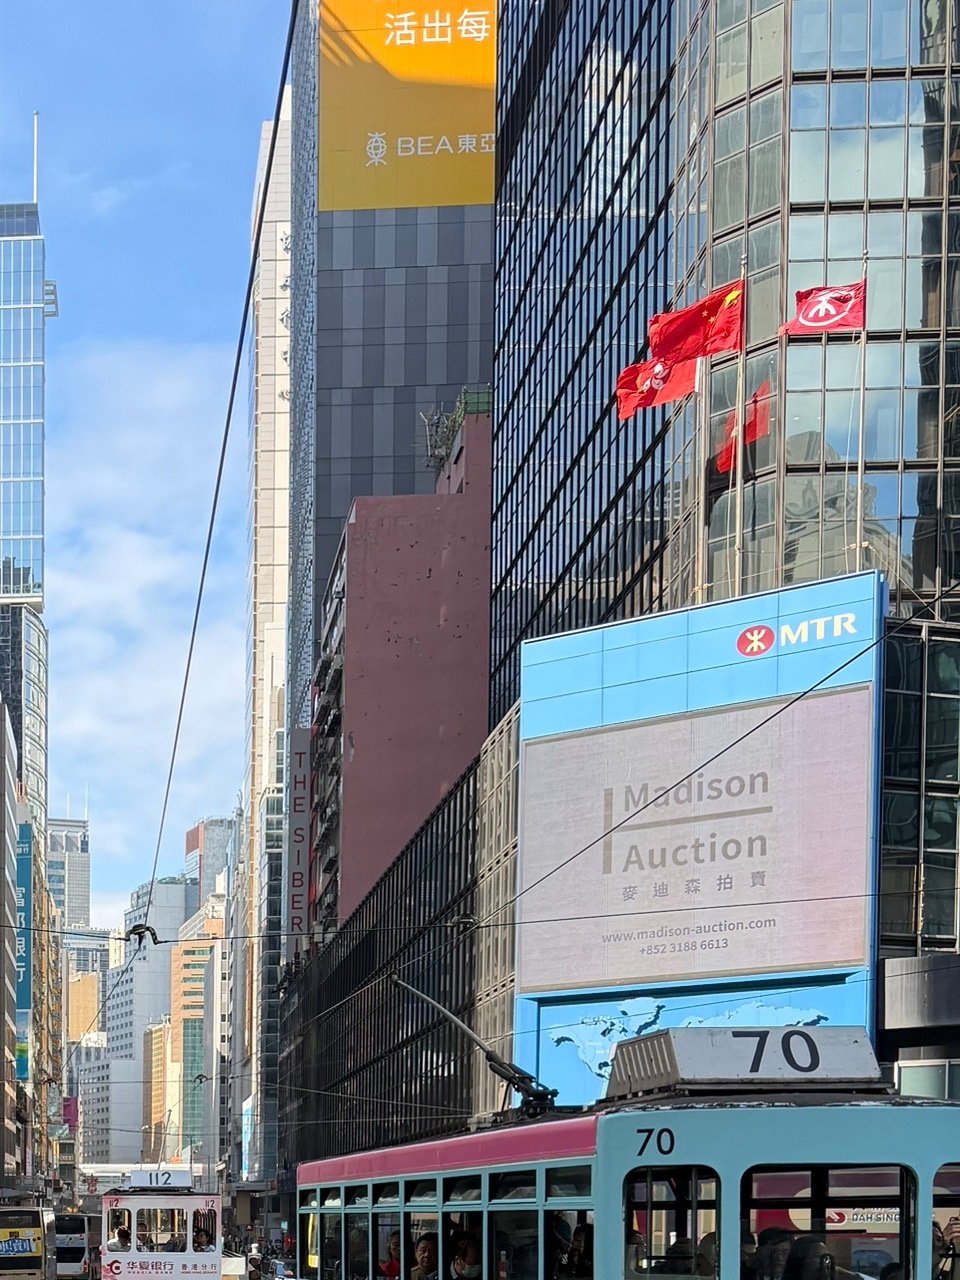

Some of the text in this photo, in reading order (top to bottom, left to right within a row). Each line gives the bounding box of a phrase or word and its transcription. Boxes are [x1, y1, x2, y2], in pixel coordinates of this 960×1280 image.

[384, 8, 491, 46] 活出每
[397, 135, 454, 156] BEA
[780, 612, 858, 647] MTR
[293, 752, 307, 814] THE
[624, 770, 769, 812] Madison
[622, 832, 767, 873] Auction
[622, 871, 767, 901] 麥迪森拍賣
[601, 917, 777, 944] www.madison-auction.com
[639, 938, 729, 956] +852 3188 6613
[731, 1029, 821, 1074] 70
[636, 1127, 675, 1157] 70
[149, 1172, 172, 1186] 112
[109, 1199, 120, 1208] 112
[205, 1199, 215, 1208] 112
[852, 1212, 874, 1224] DAH
[126, 1260, 174, 1271] 华夏银行
[181, 1263, 218, 1271] 香港分行
